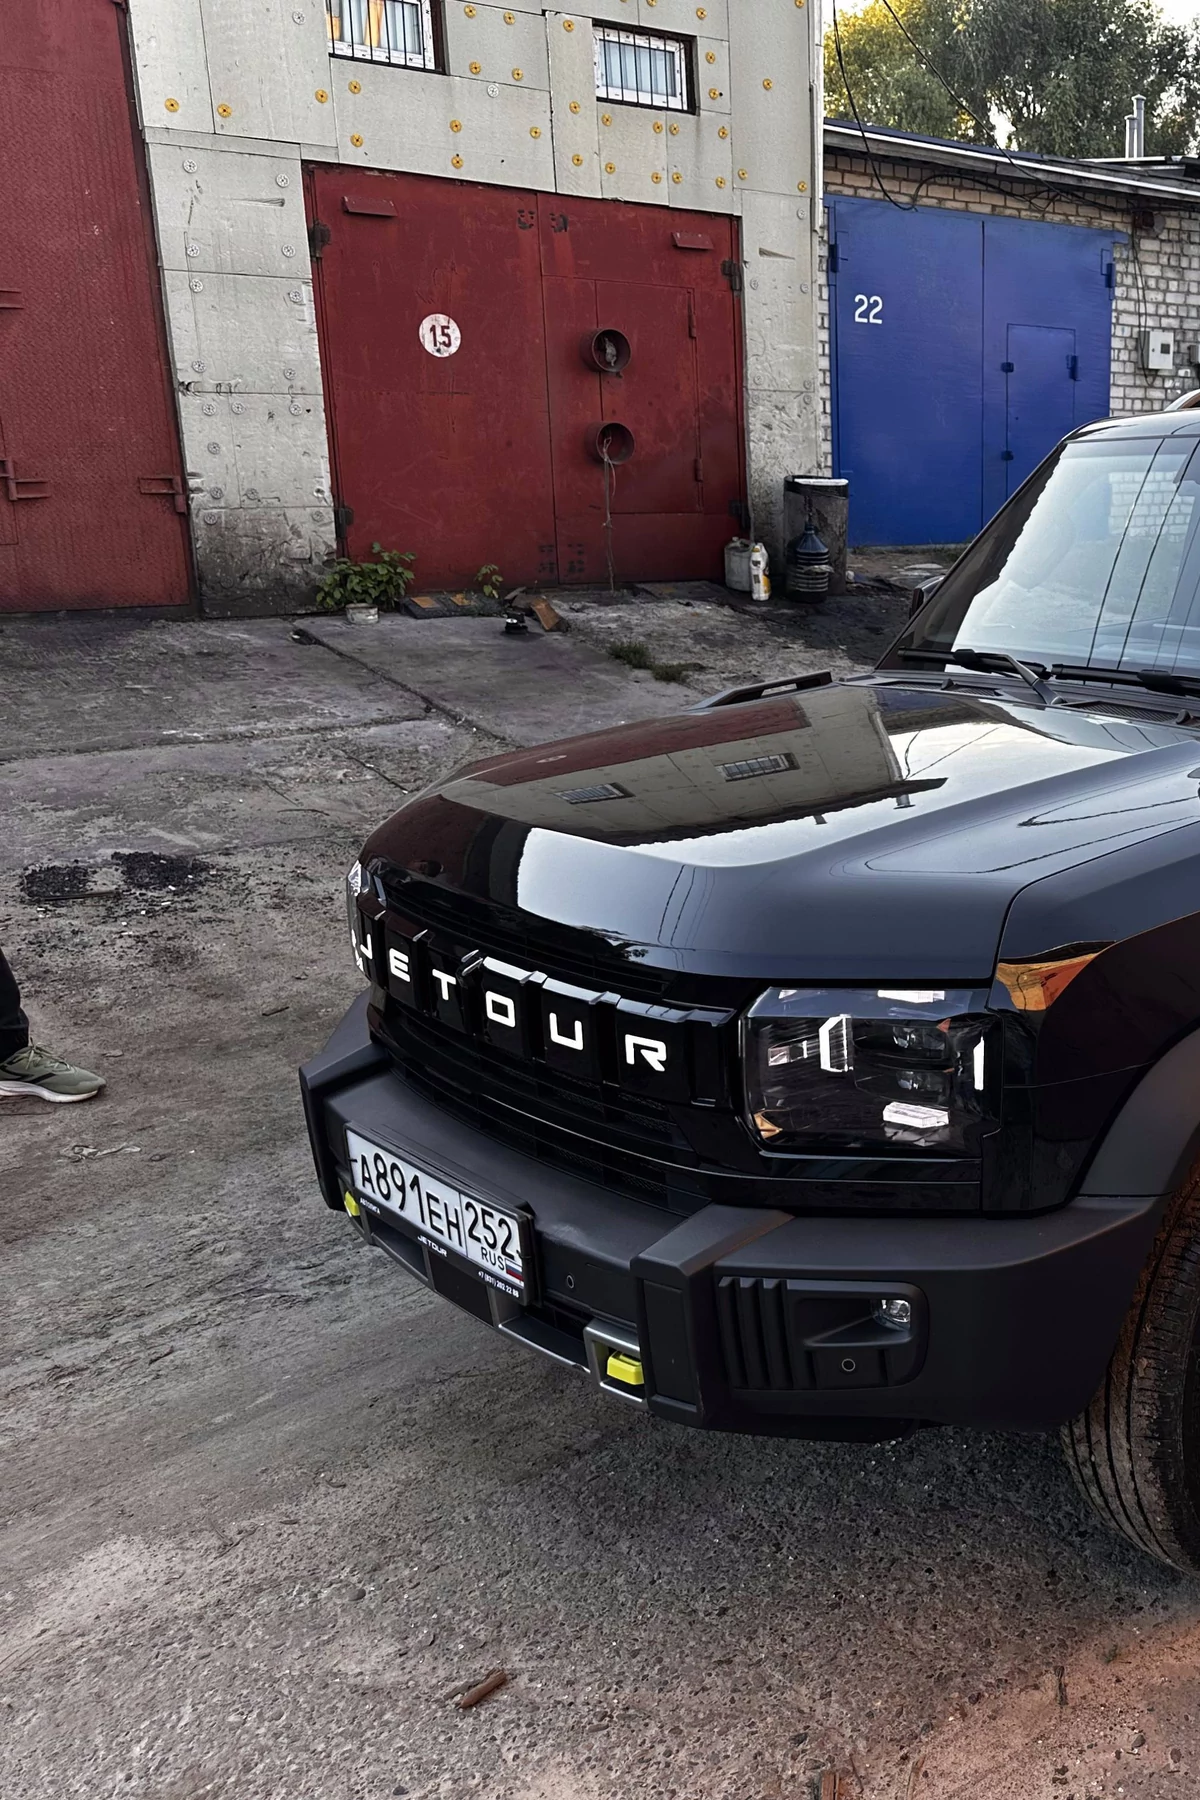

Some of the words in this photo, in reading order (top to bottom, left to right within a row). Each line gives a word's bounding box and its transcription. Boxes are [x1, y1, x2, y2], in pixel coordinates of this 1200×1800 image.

[854, 294, 883, 325] 22
[429, 324, 452, 348] 15
[360, 933, 667, 1072] JETOUR
[464, 1200, 517, 1261] 252
[417, 1234, 448, 1258] JETOUR
[480, 1246, 505, 1272] RUS
